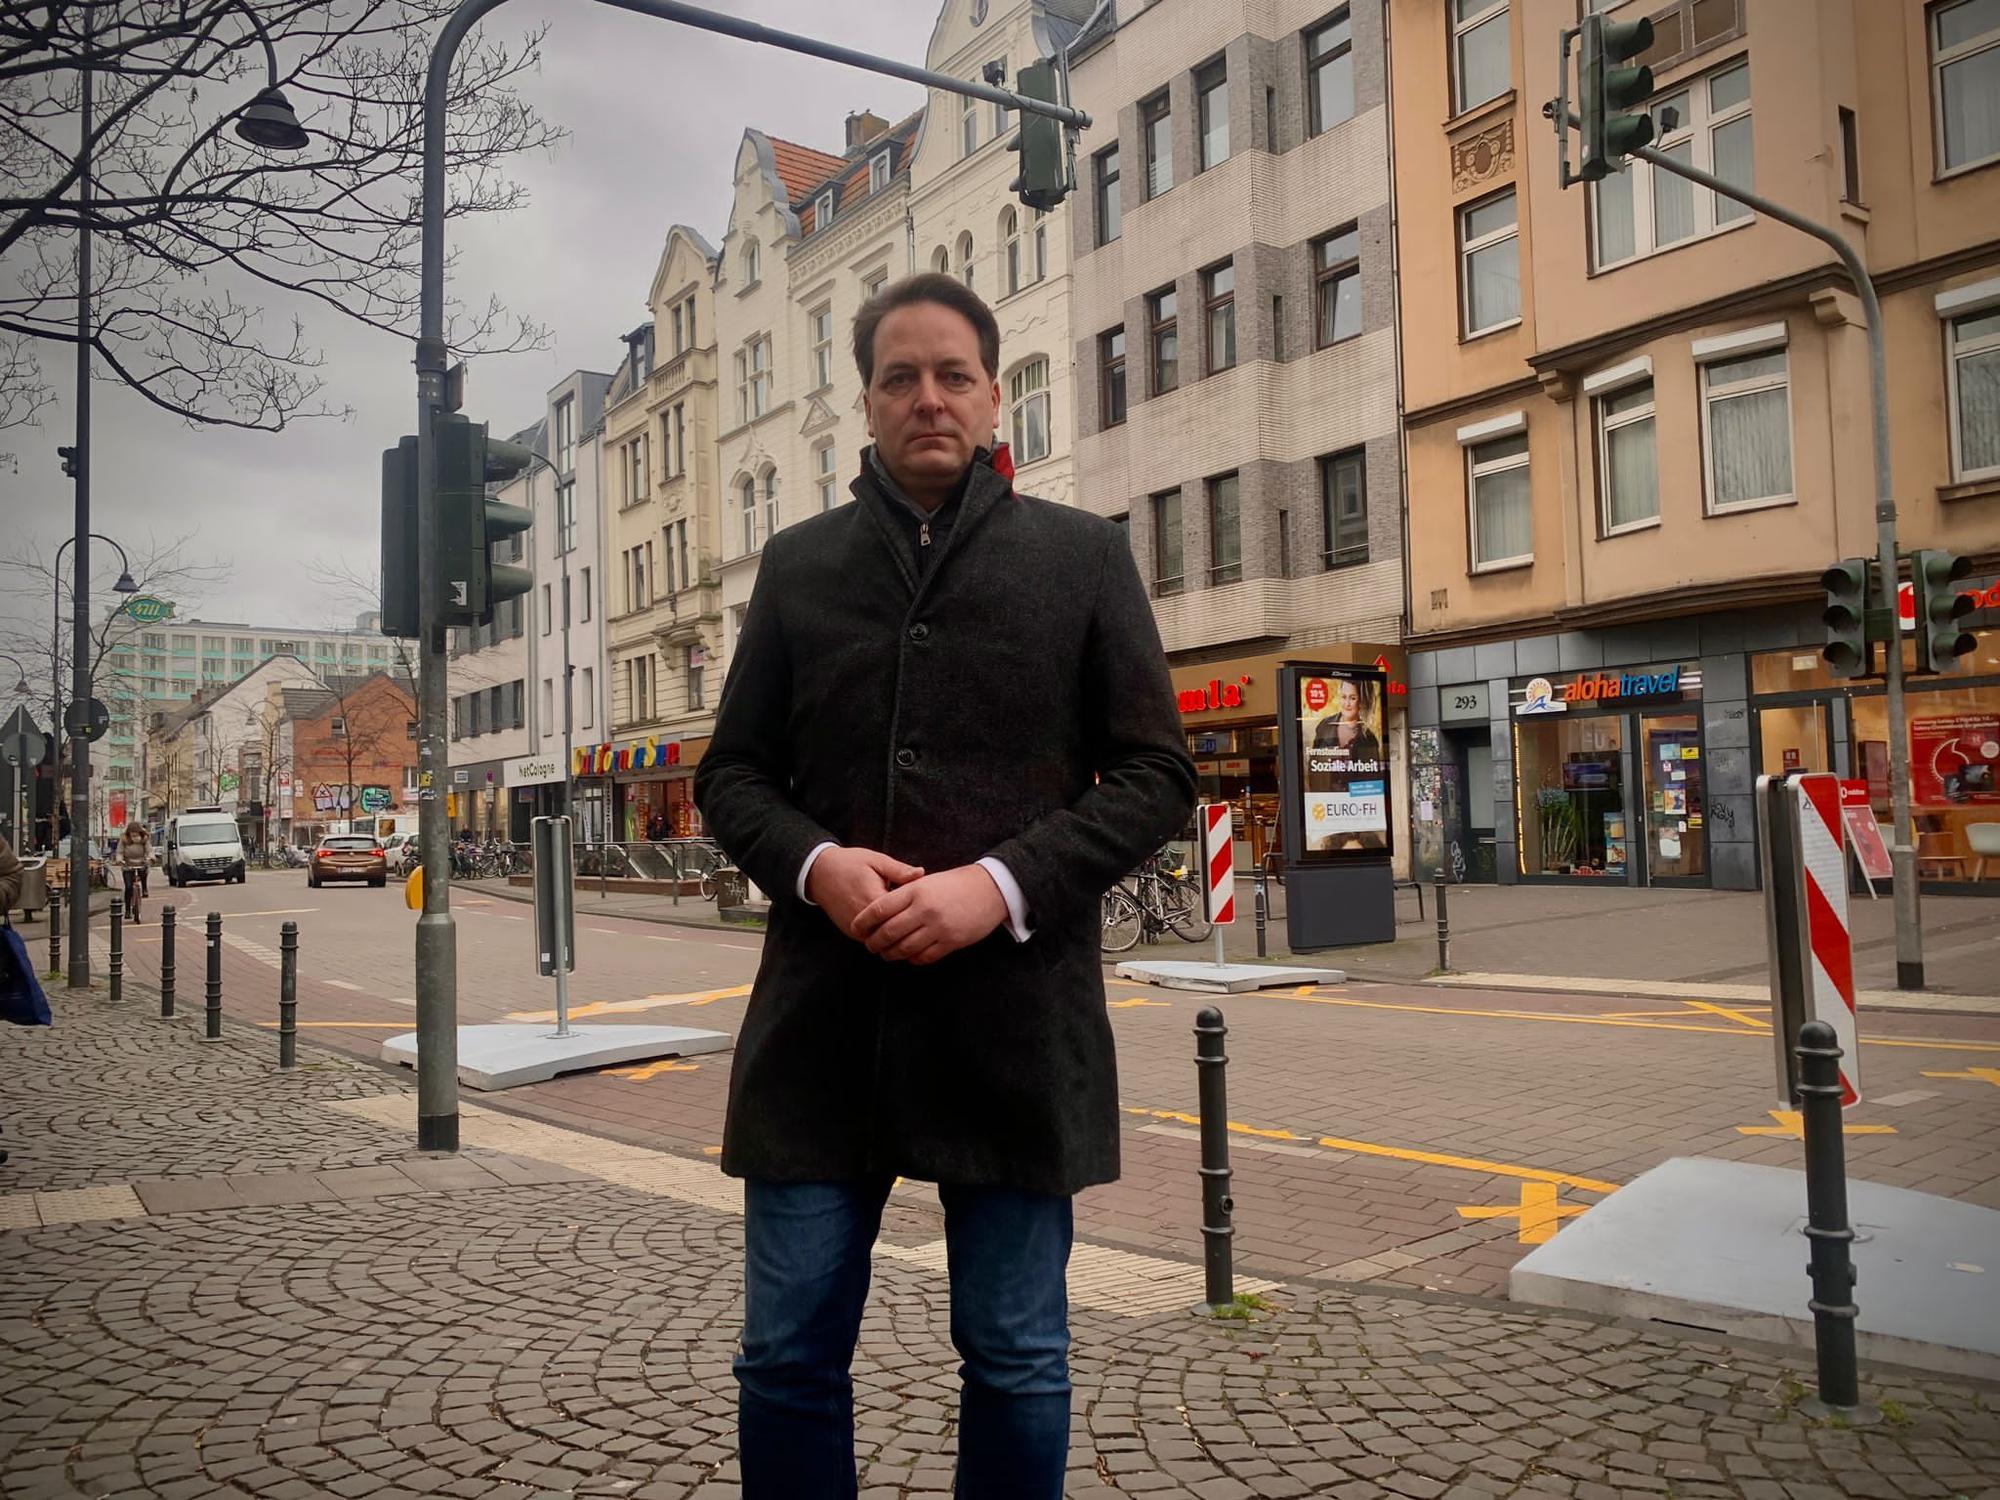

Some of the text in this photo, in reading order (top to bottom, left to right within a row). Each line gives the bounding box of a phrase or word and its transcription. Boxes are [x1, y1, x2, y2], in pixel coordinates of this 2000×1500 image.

[1564, 664, 1681, 701] alohatravel
[1178, 679, 1241, 712] mla
[1454, 695, 1477, 709] 293
[518, 763, 555, 781] NetCologne
[1311, 758, 1379, 772] Soziale Arbeit
[1327, 803, 1377, 817] EURO-FH
